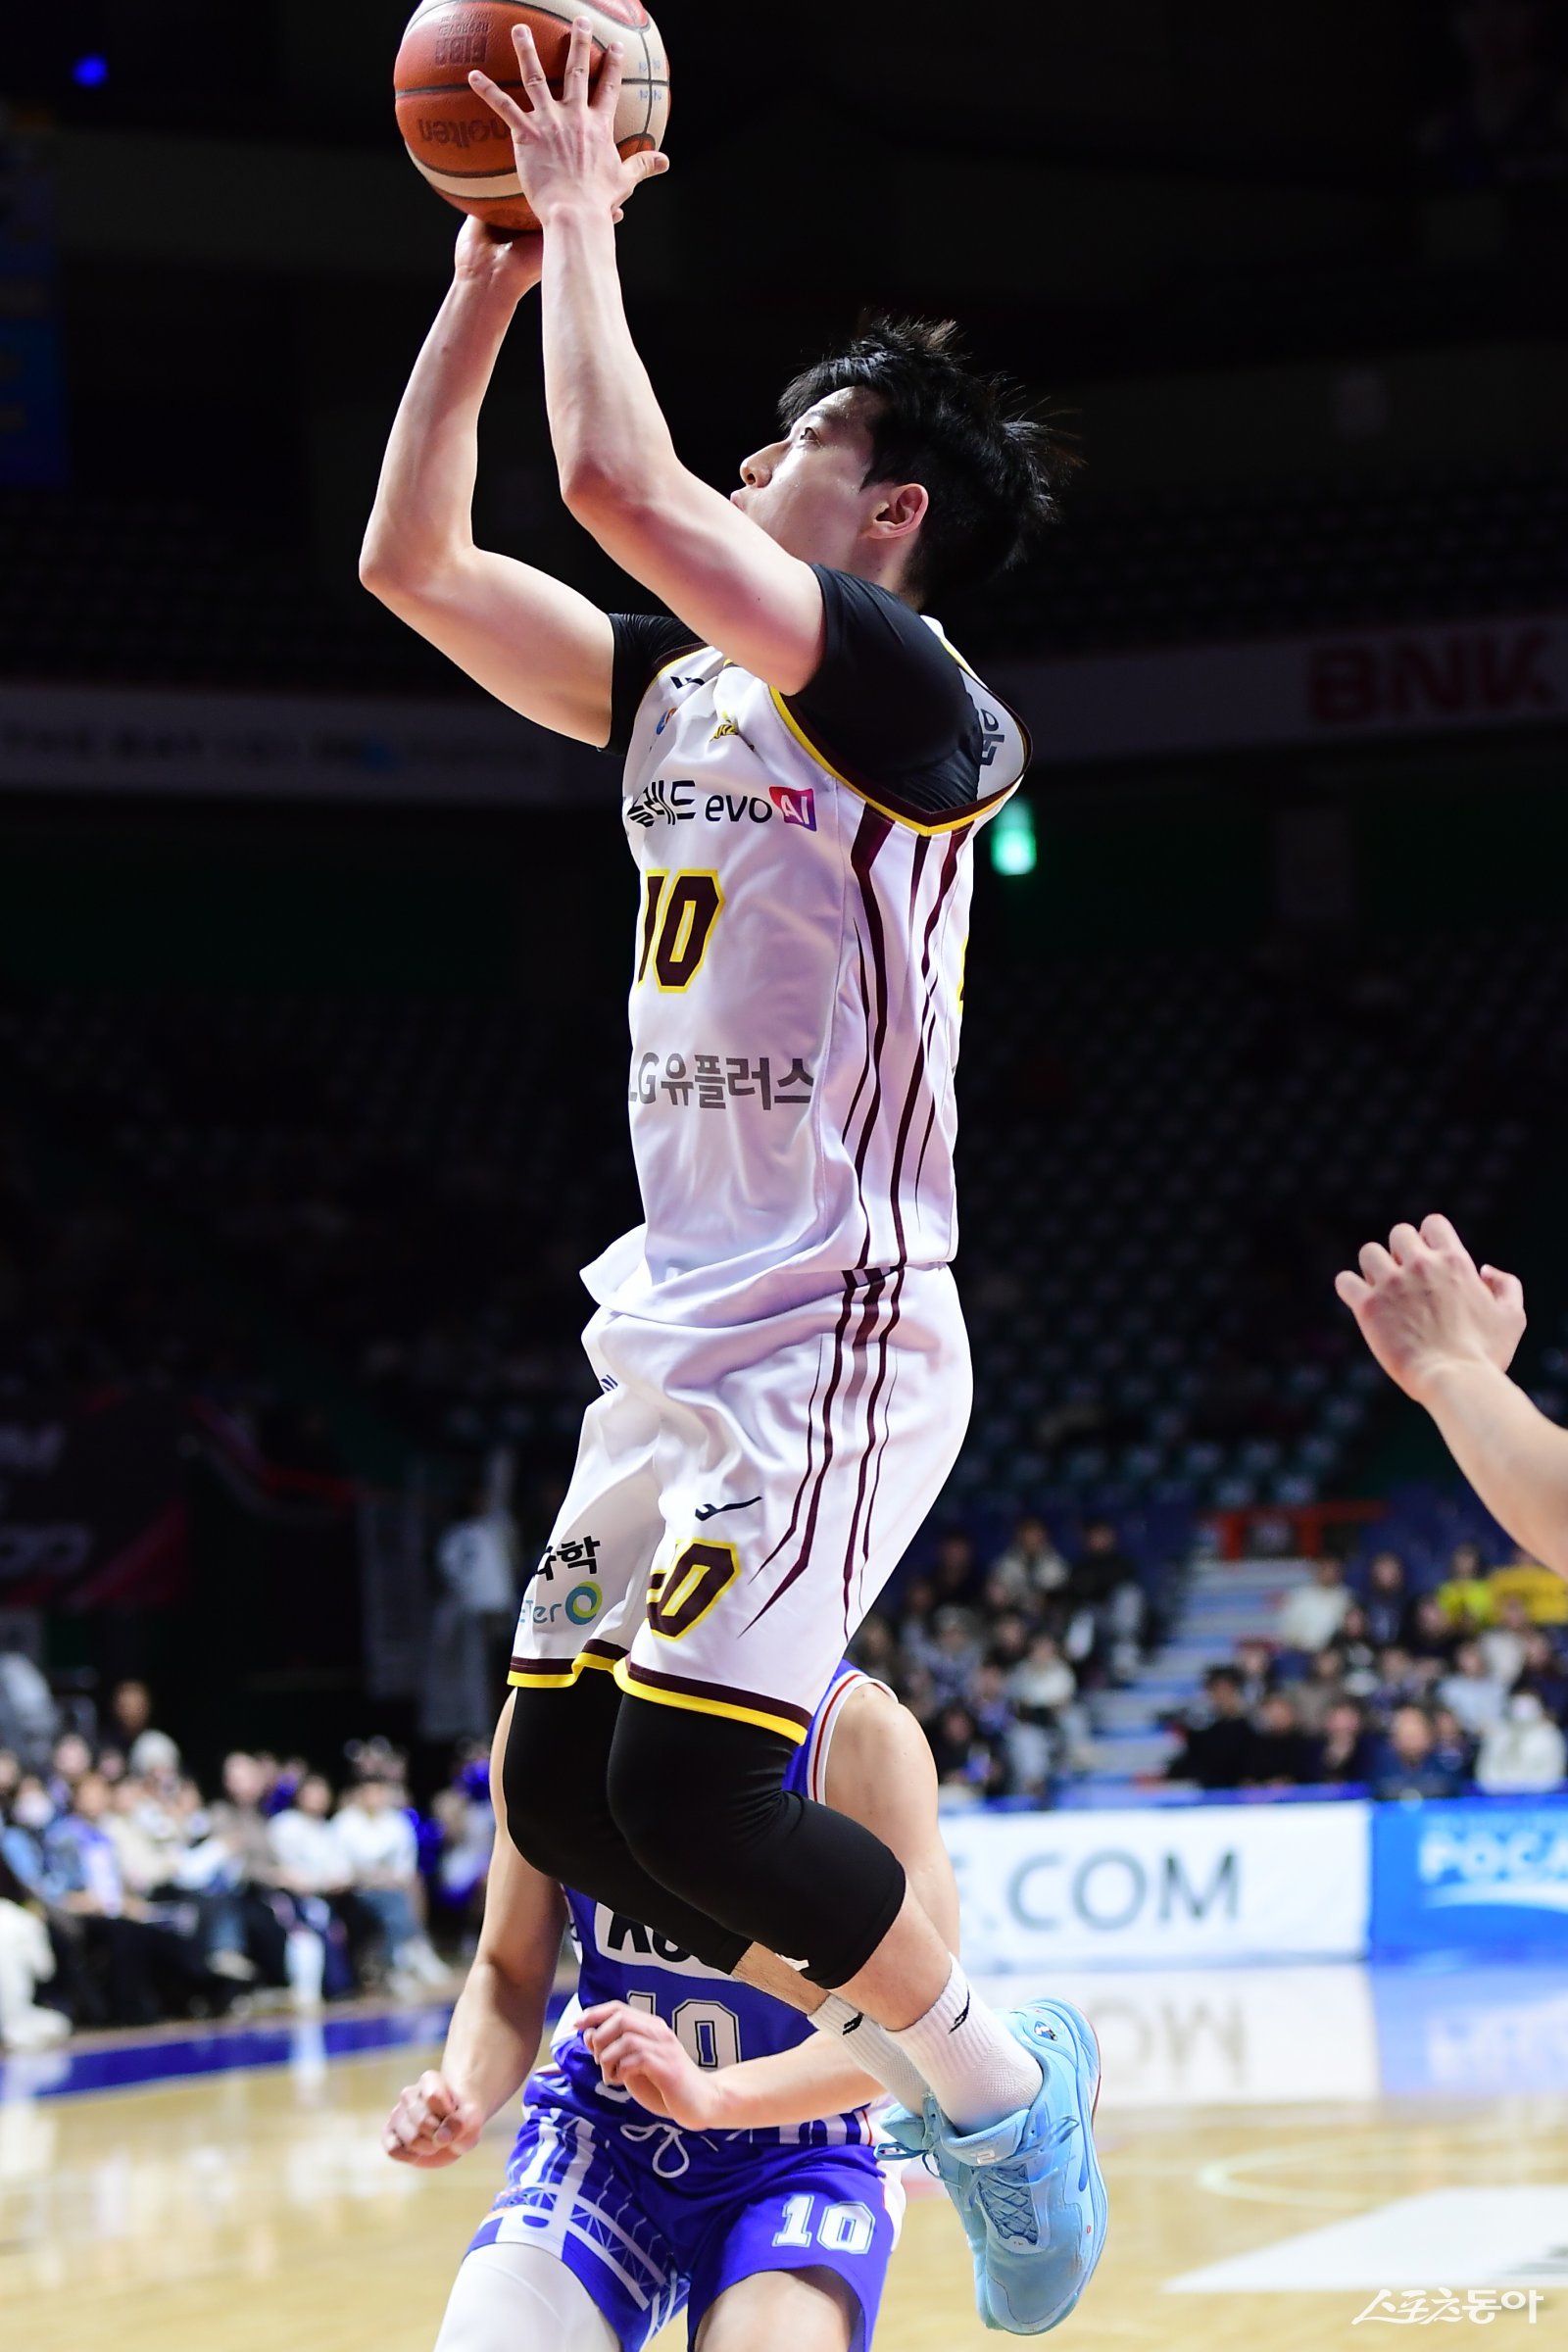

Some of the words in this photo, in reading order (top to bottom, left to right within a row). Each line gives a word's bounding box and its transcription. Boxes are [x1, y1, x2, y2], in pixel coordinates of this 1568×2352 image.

[1308, 631, 1554, 723] BNK
[705, 794, 773, 824] evo
[779, 793, 811, 825] AI
[637, 868, 726, 994] 10
[771, 2193, 877, 2255] 10
